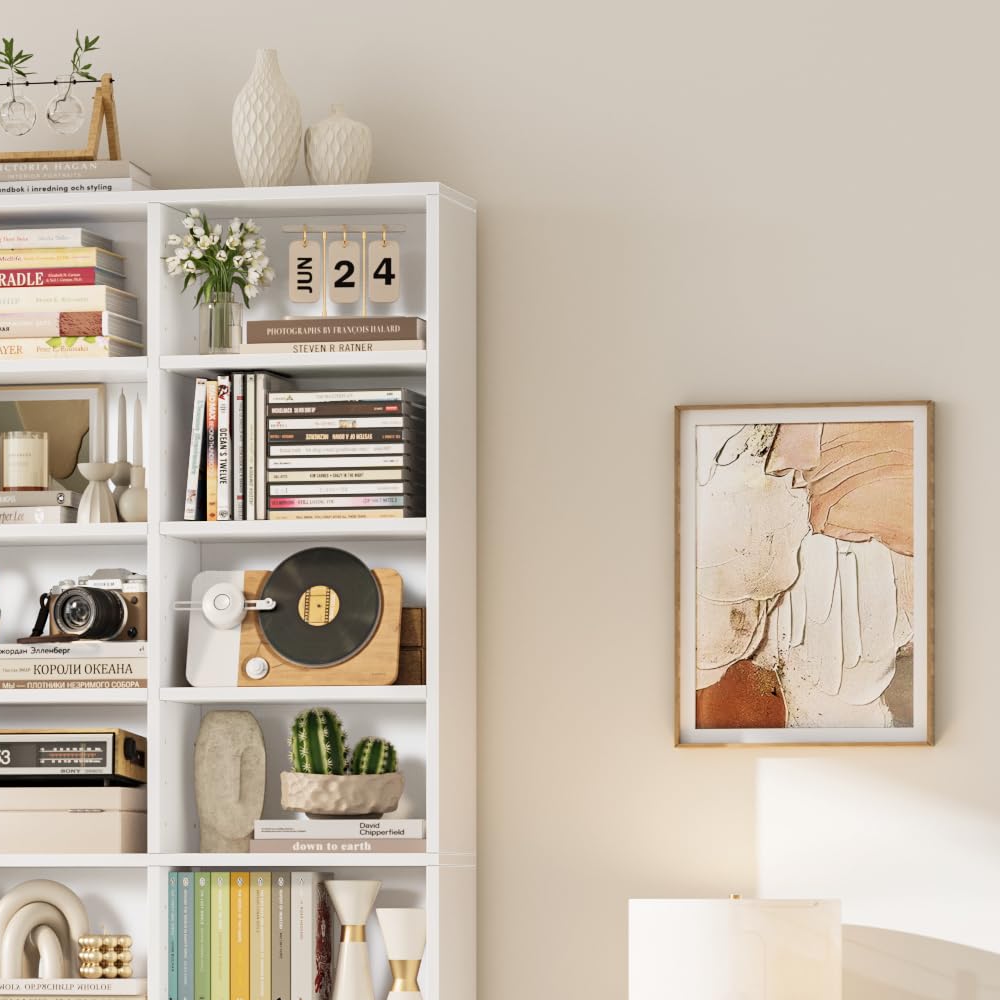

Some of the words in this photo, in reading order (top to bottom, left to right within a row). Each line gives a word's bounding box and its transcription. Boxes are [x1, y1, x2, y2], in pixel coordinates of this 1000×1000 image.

[55, 162, 98, 170] HAGAN
[31, 184, 68, 194] inredning
[86, 184, 112, 192] styling
[297, 258, 312, 293] JUN
[334, 260, 355, 288] 2
[373, 258, 395, 285] 4
[266, 326, 321, 336] PHOTOGRAPHS
[323, 326, 332, 335] BY
[370, 325, 400, 333] HALARD
[293, 344, 326, 353] STEVEN
[329, 344, 336, 352] R
[339, 343, 373, 352] RATNER
[219, 459, 227, 484] TWELVE
[13, 511, 24, 521] Lee
[31, 646, 71, 655] Элленберг
[33, 664, 81, 675] КОРОЛИ
[84, 663, 133, 674] ОКЕАНА
[292, 841, 323, 850] down
[327, 842, 337, 850] to
[340, 841, 372, 851] earth
